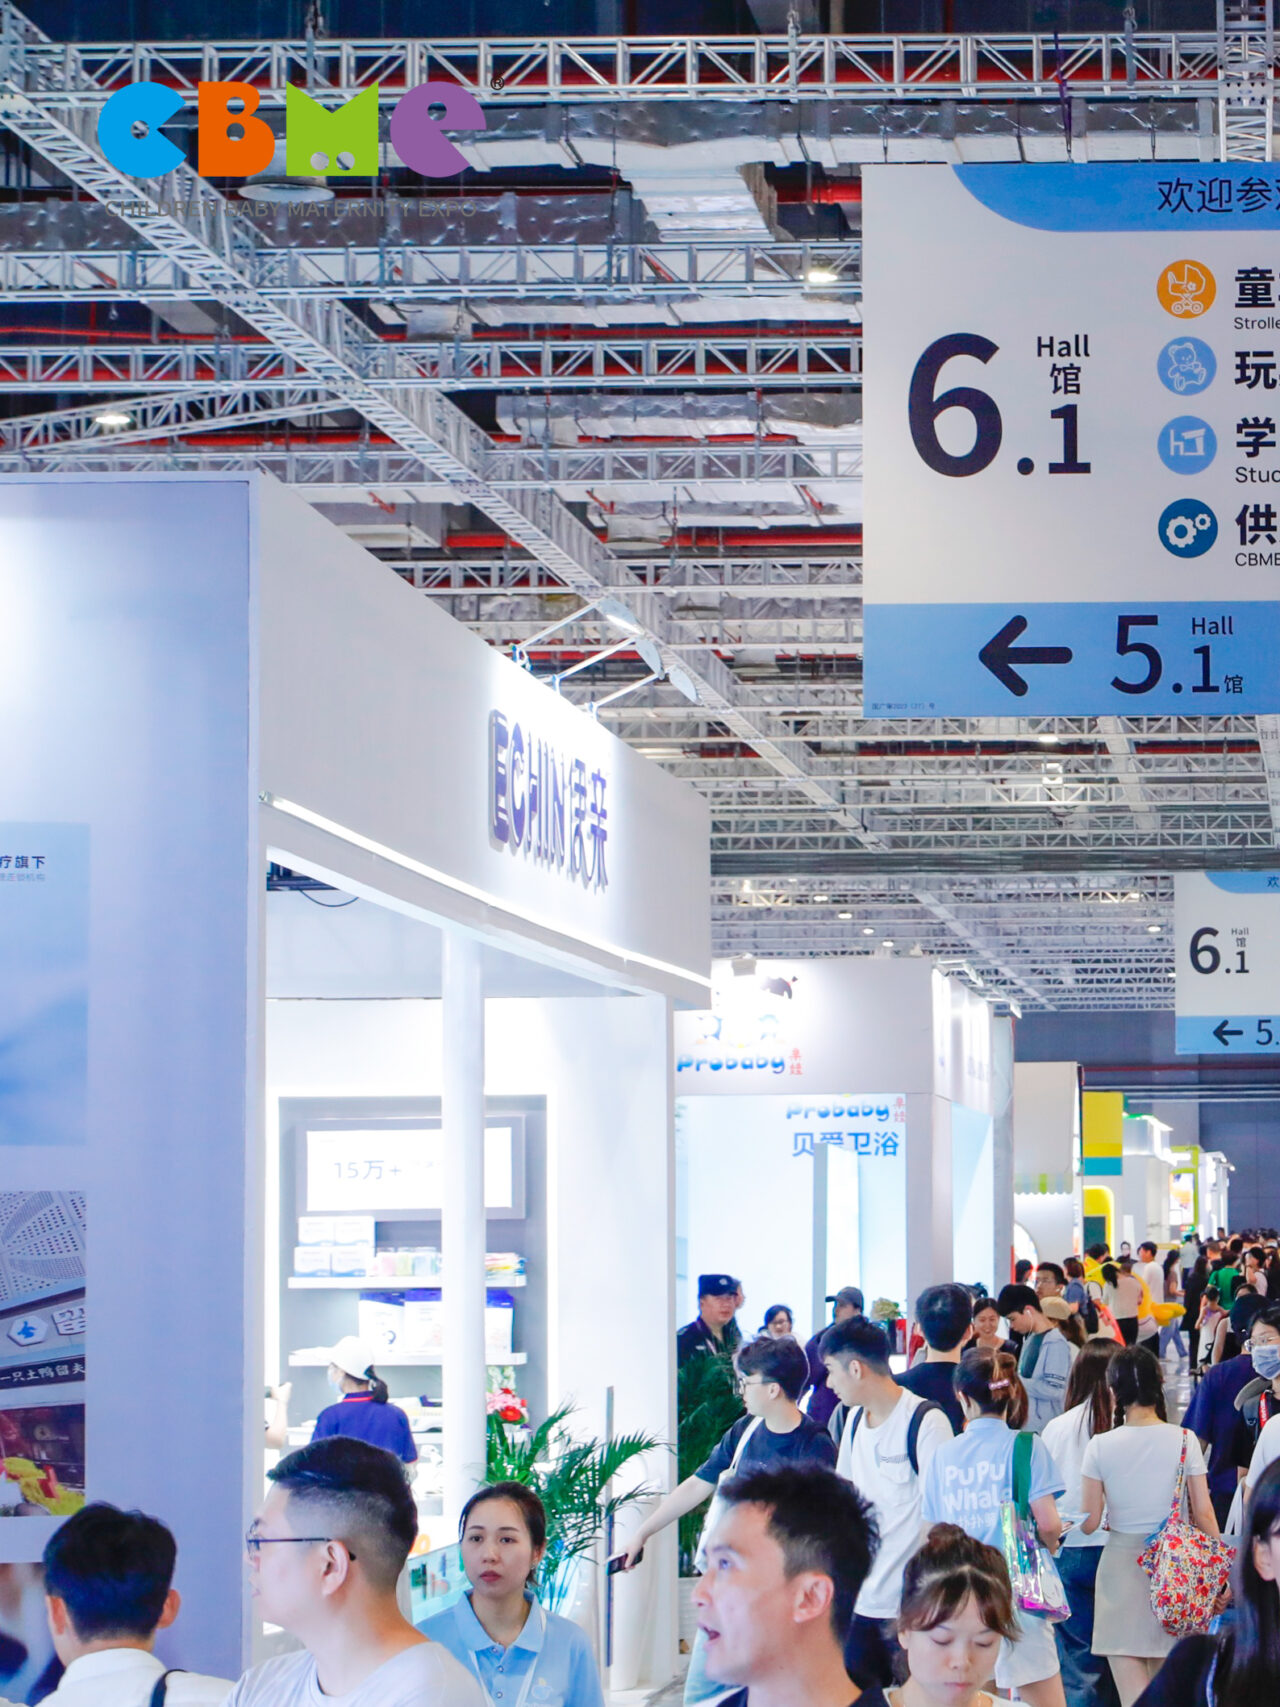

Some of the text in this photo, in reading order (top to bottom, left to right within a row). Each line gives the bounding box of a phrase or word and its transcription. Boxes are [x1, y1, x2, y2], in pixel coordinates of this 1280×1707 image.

[1037, 334, 1090, 358] Hall
[1049, 362, 1082, 395] 馆
[1191, 615, 1234, 635] Hall
[1223, 674, 1244, 694] 馆
[490, 709, 565, 868] ECHIN
[1231, 927, 1249, 936] Hall
